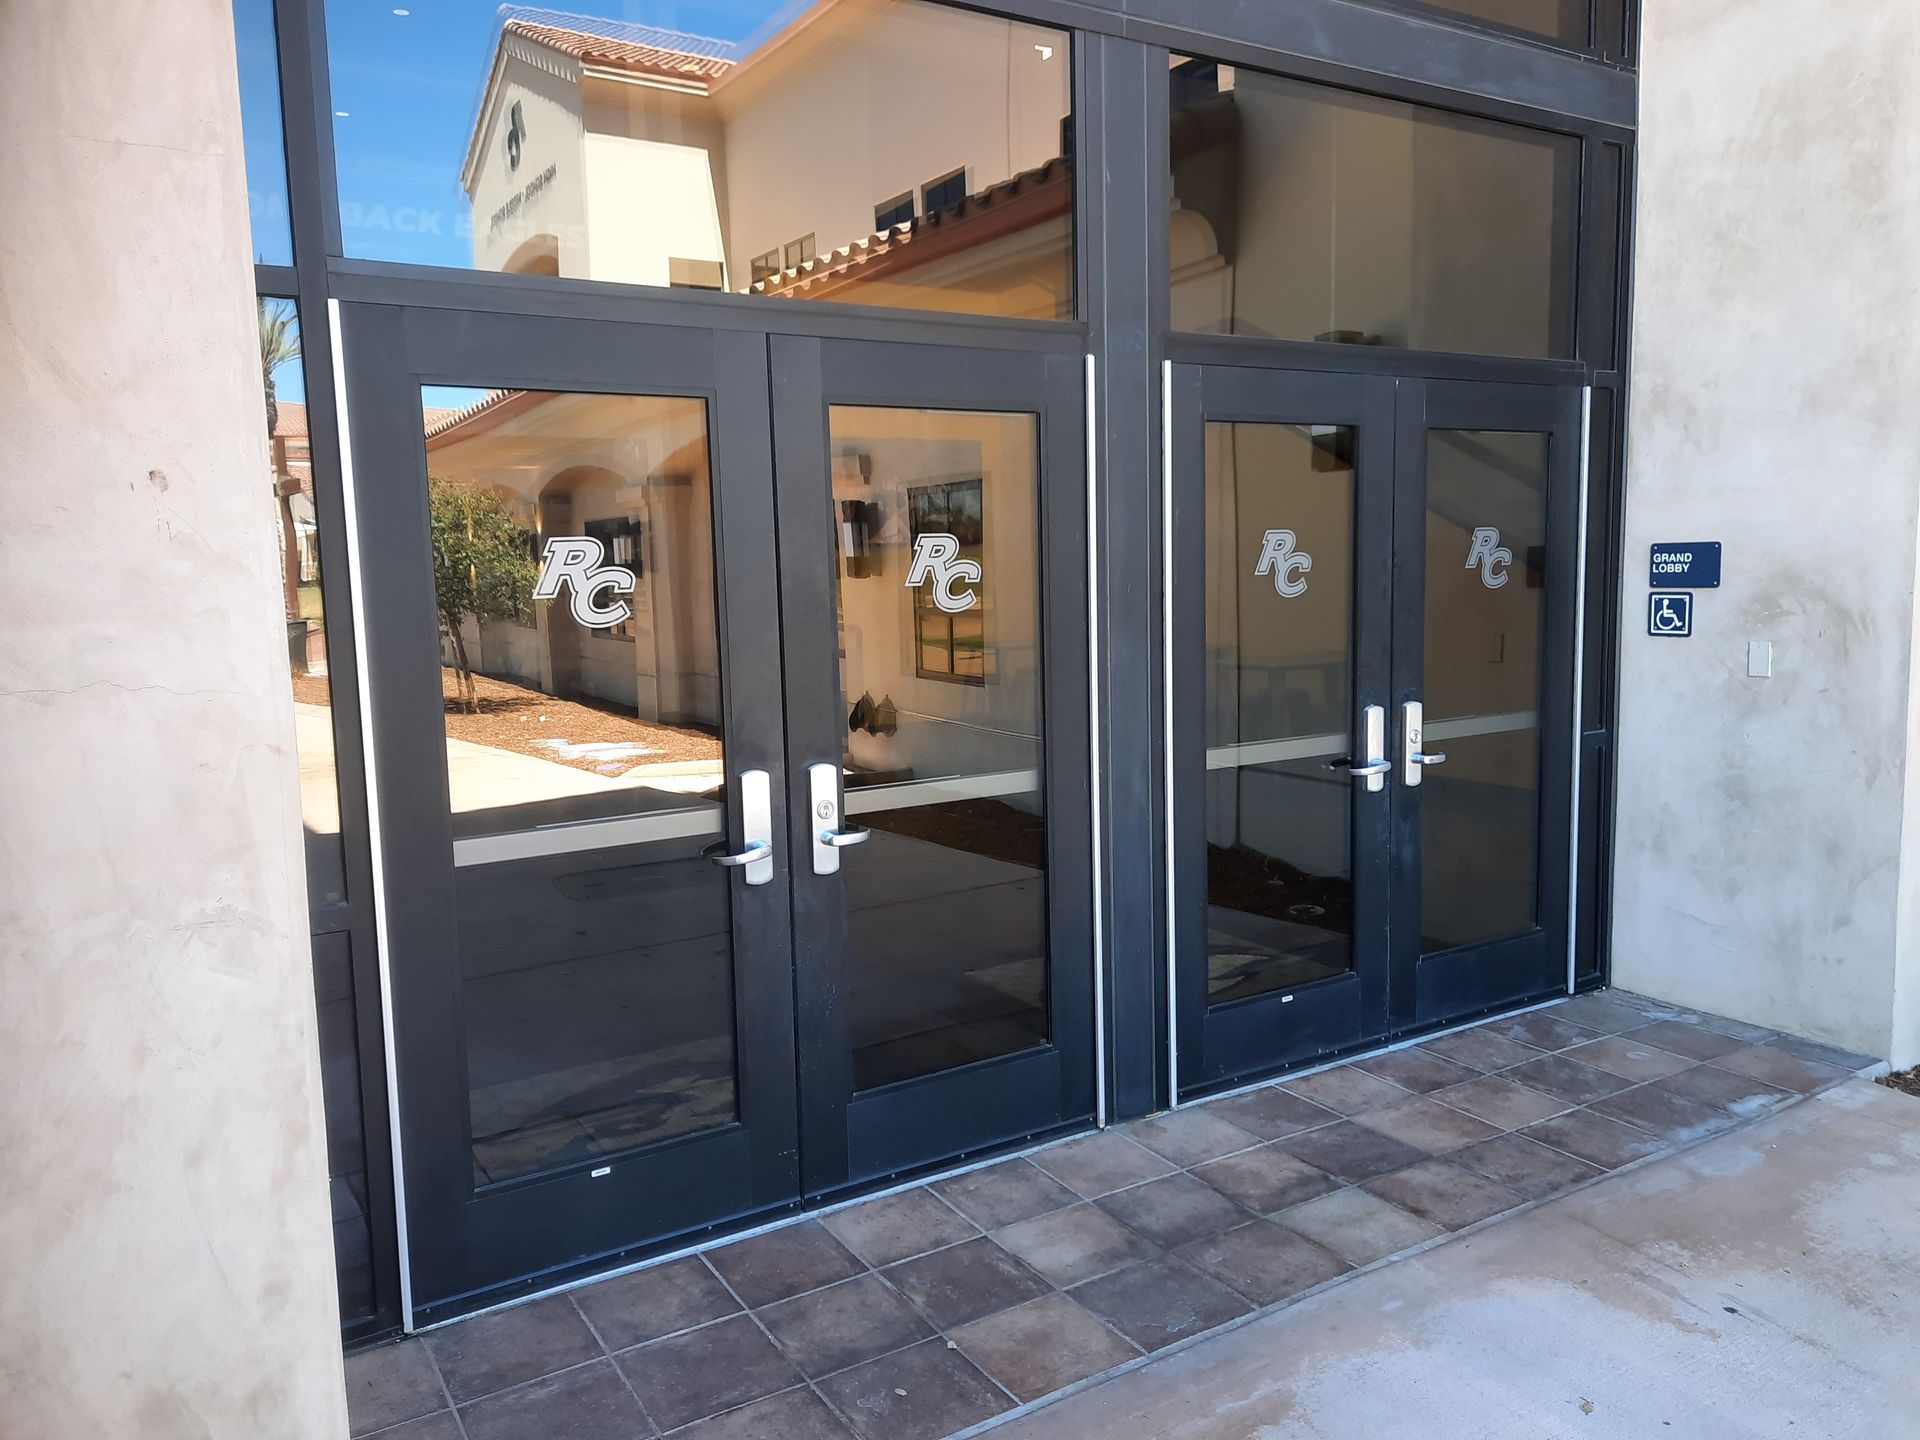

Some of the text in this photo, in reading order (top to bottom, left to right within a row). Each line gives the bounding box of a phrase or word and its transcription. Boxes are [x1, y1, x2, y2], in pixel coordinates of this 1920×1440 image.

[343, 201, 442, 235] BACK
[532, 535, 636, 629] RC
[905, 532, 983, 614] RC
[1254, 528, 1312, 599] RC
[1465, 526, 1513, 588] RC
[1652, 564, 1689, 573] LOBBY
[1653, 553, 1692, 562] GRAND
